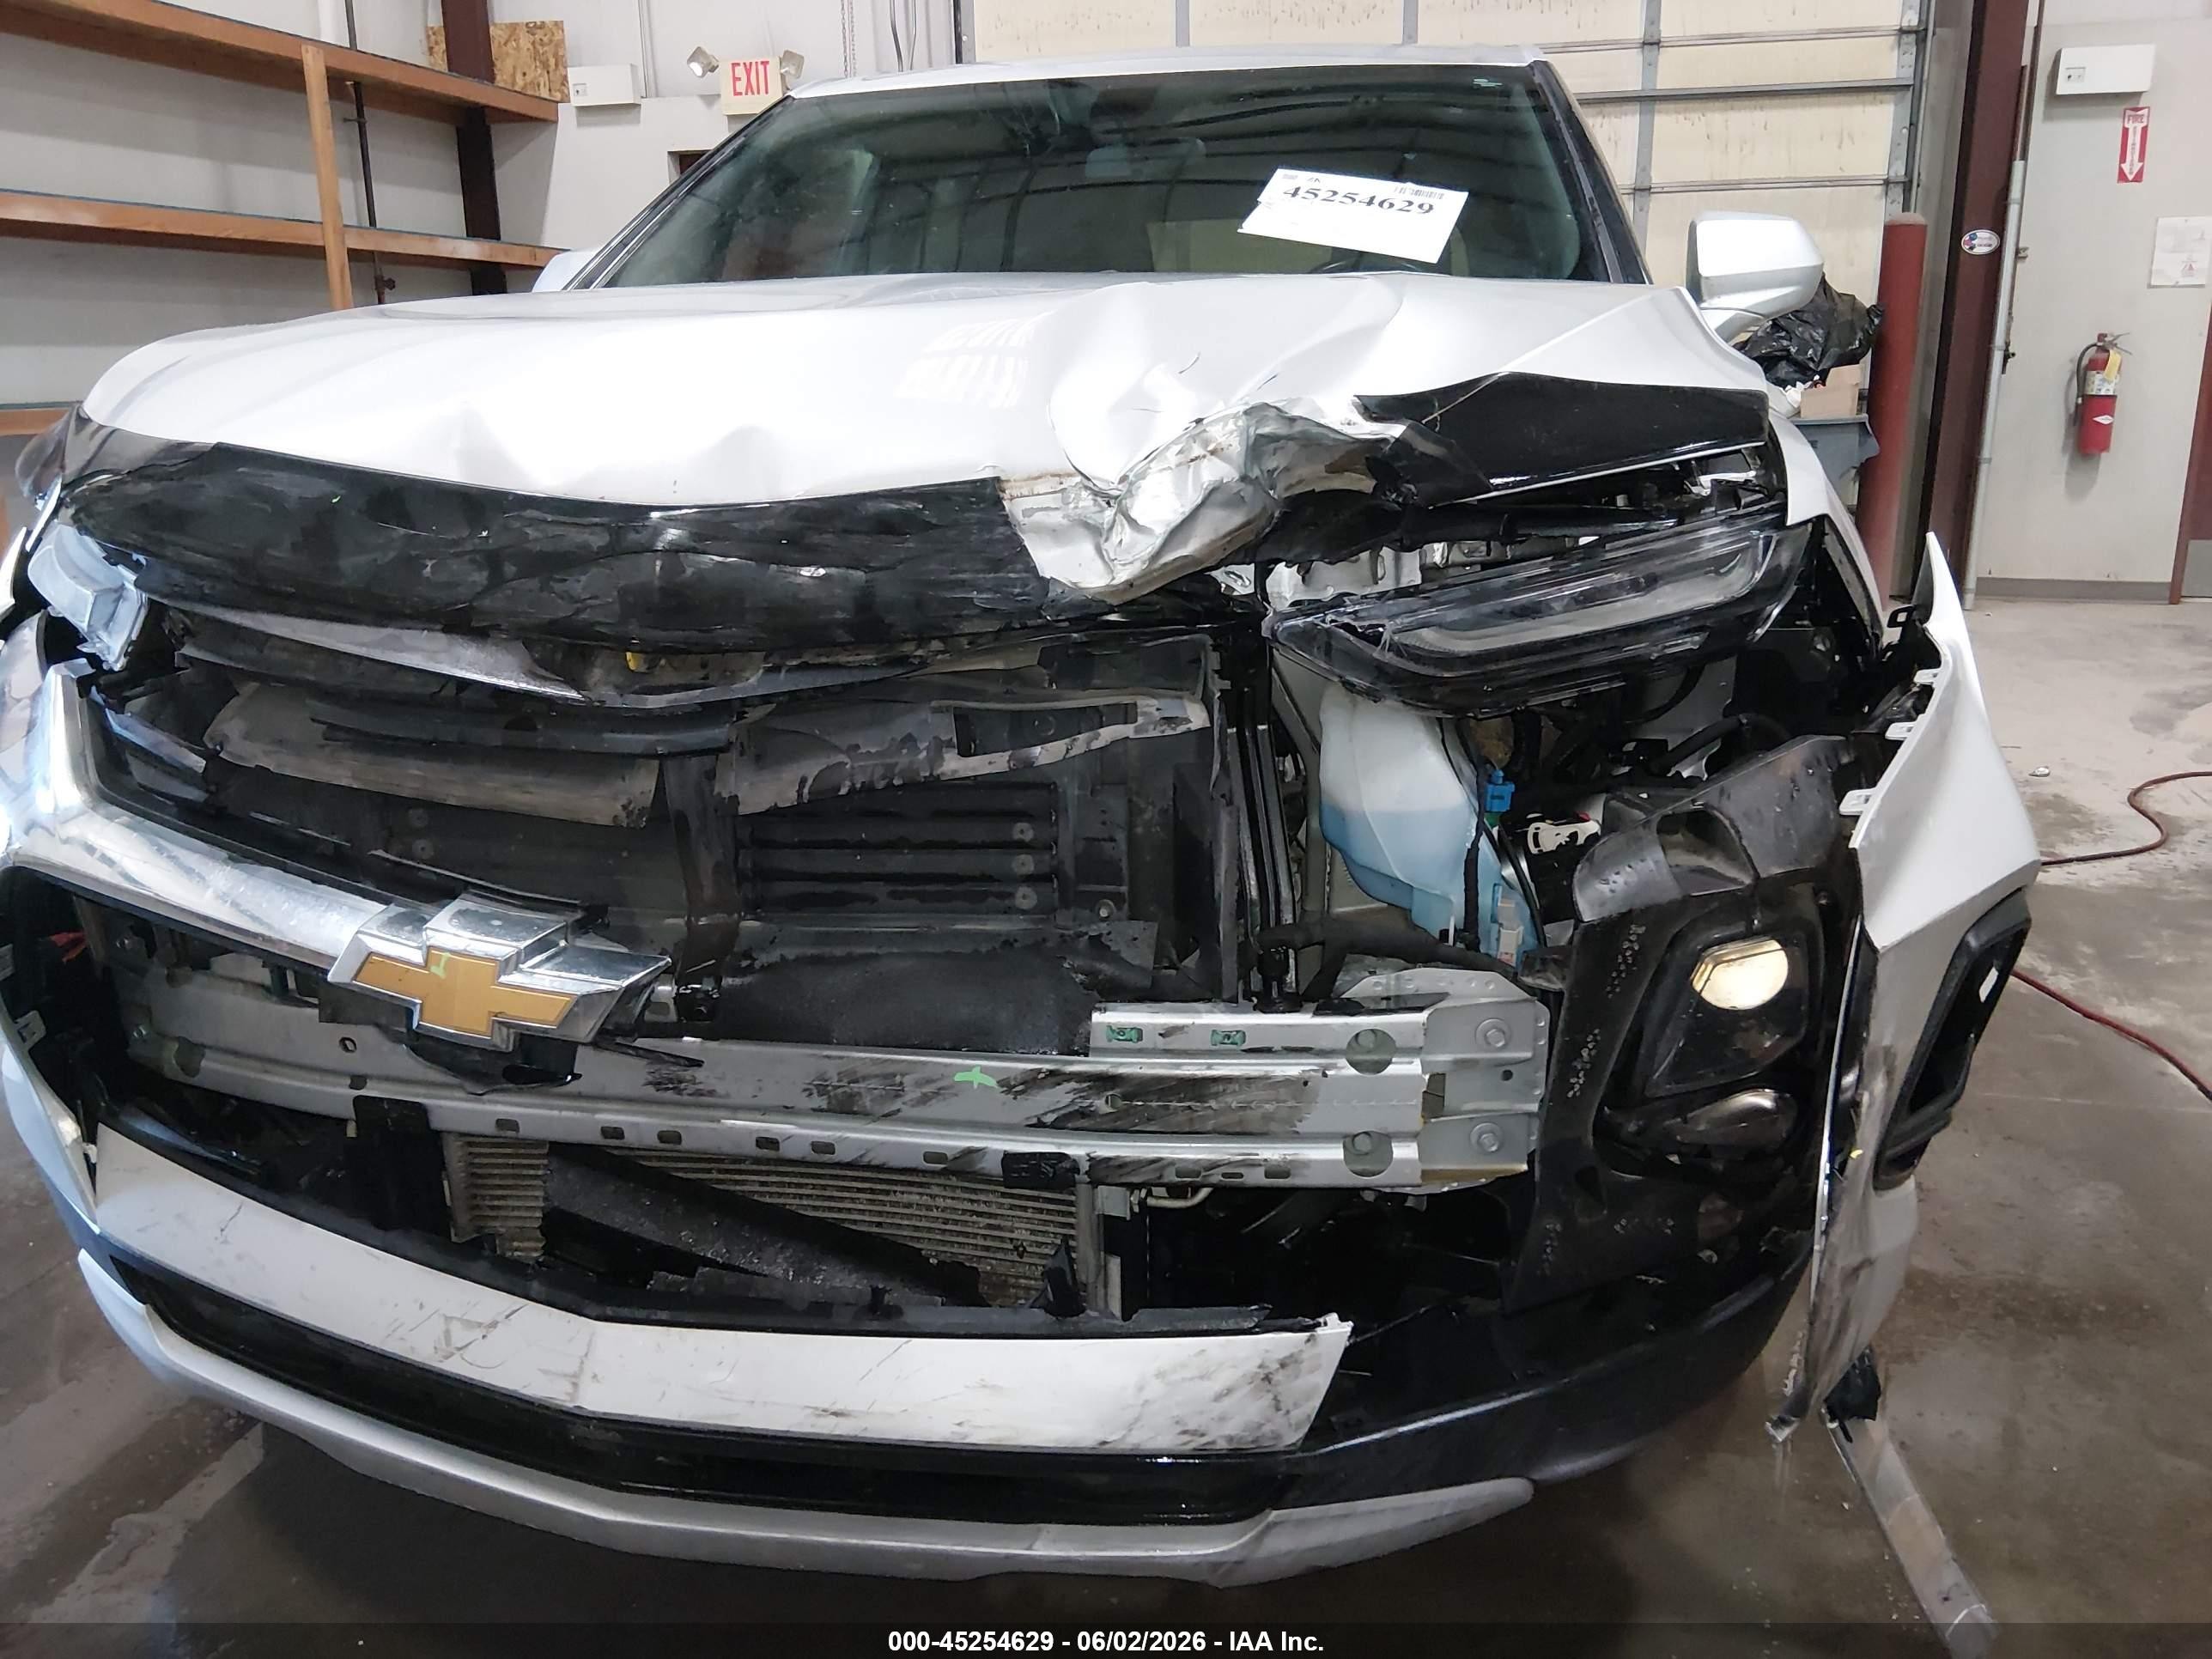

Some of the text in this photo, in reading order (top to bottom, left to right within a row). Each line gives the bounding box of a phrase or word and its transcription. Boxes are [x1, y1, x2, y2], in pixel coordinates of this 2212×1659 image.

[731, 60, 770, 97] EXIT
[2127, 113, 2144, 125] FIRE
[1282, 185, 1435, 215] 45254629
